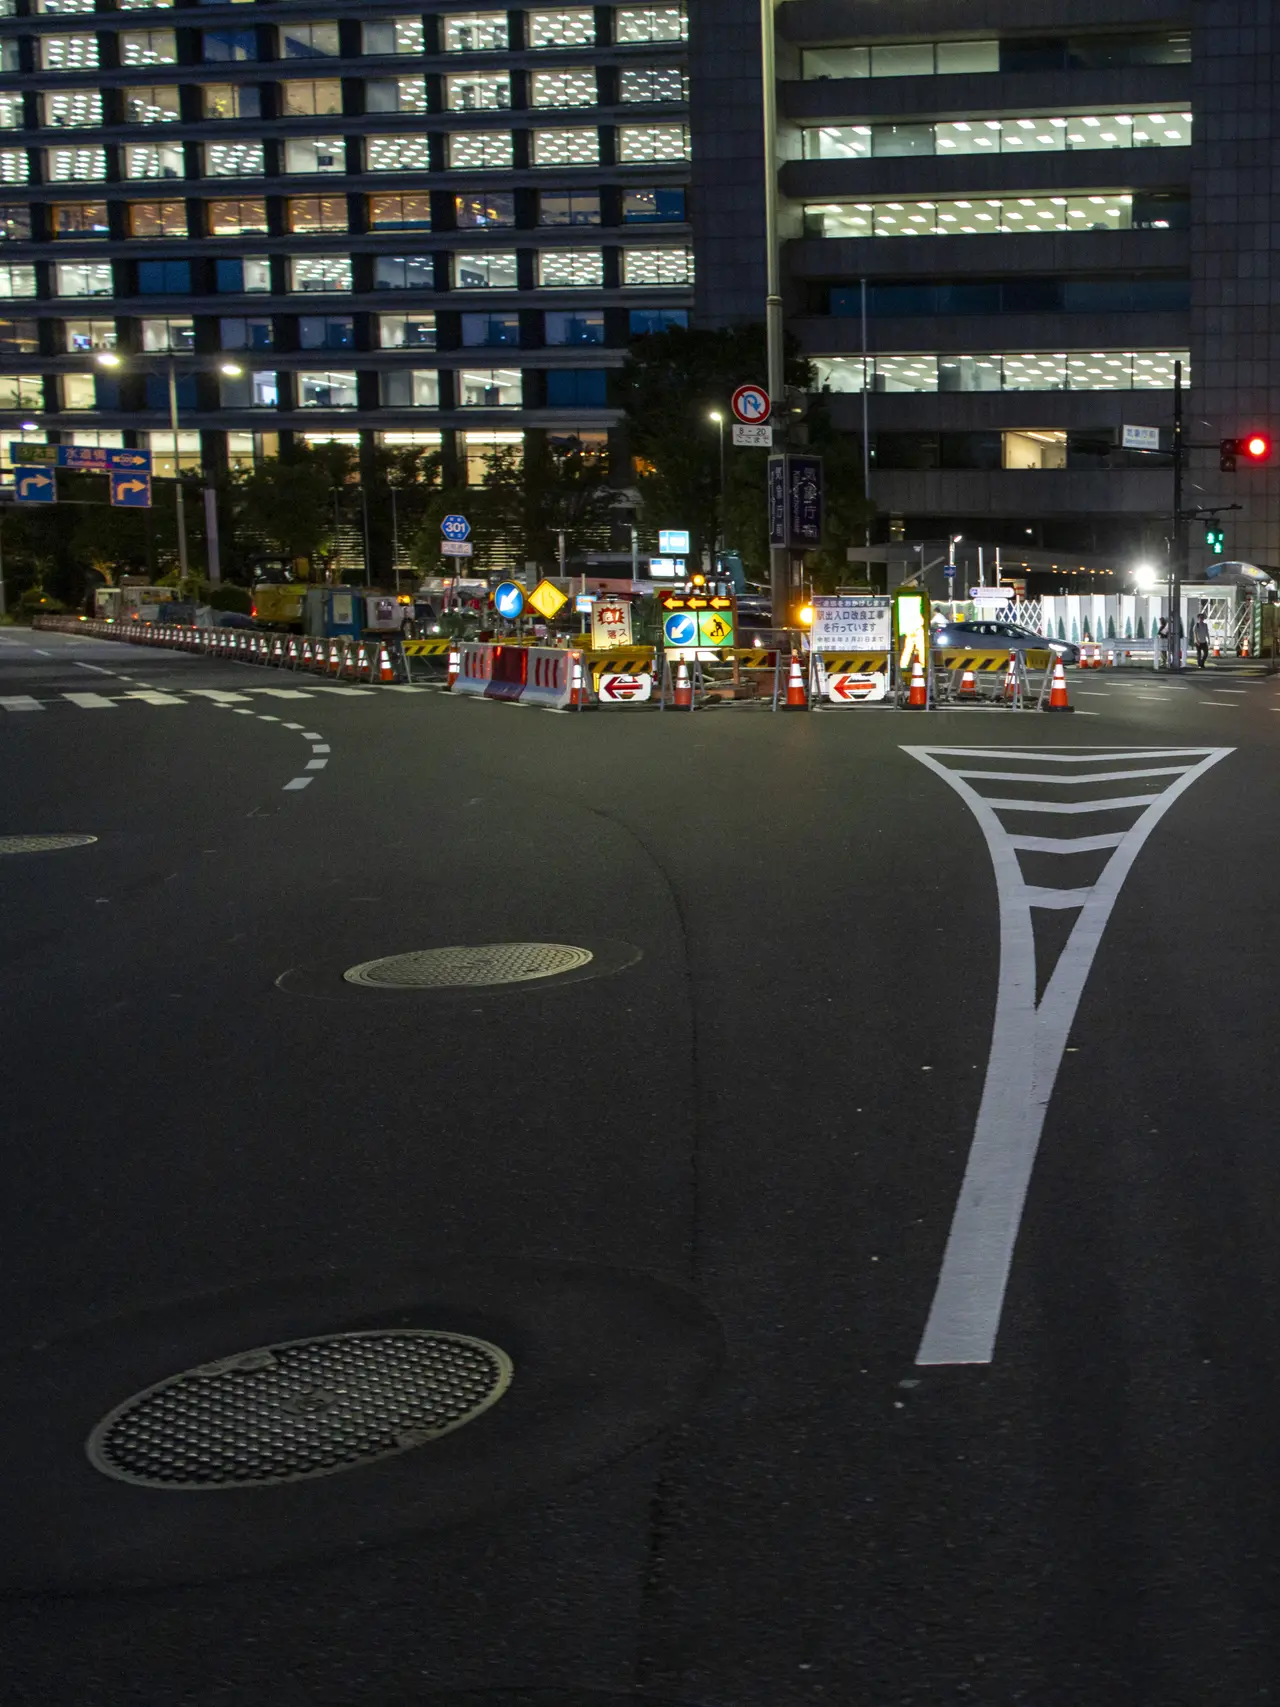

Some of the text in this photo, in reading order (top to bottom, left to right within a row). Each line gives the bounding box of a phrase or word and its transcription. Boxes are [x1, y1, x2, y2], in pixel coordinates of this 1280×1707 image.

[445, 522, 465, 532] 301
[823, 623, 876, 632] を行っています
